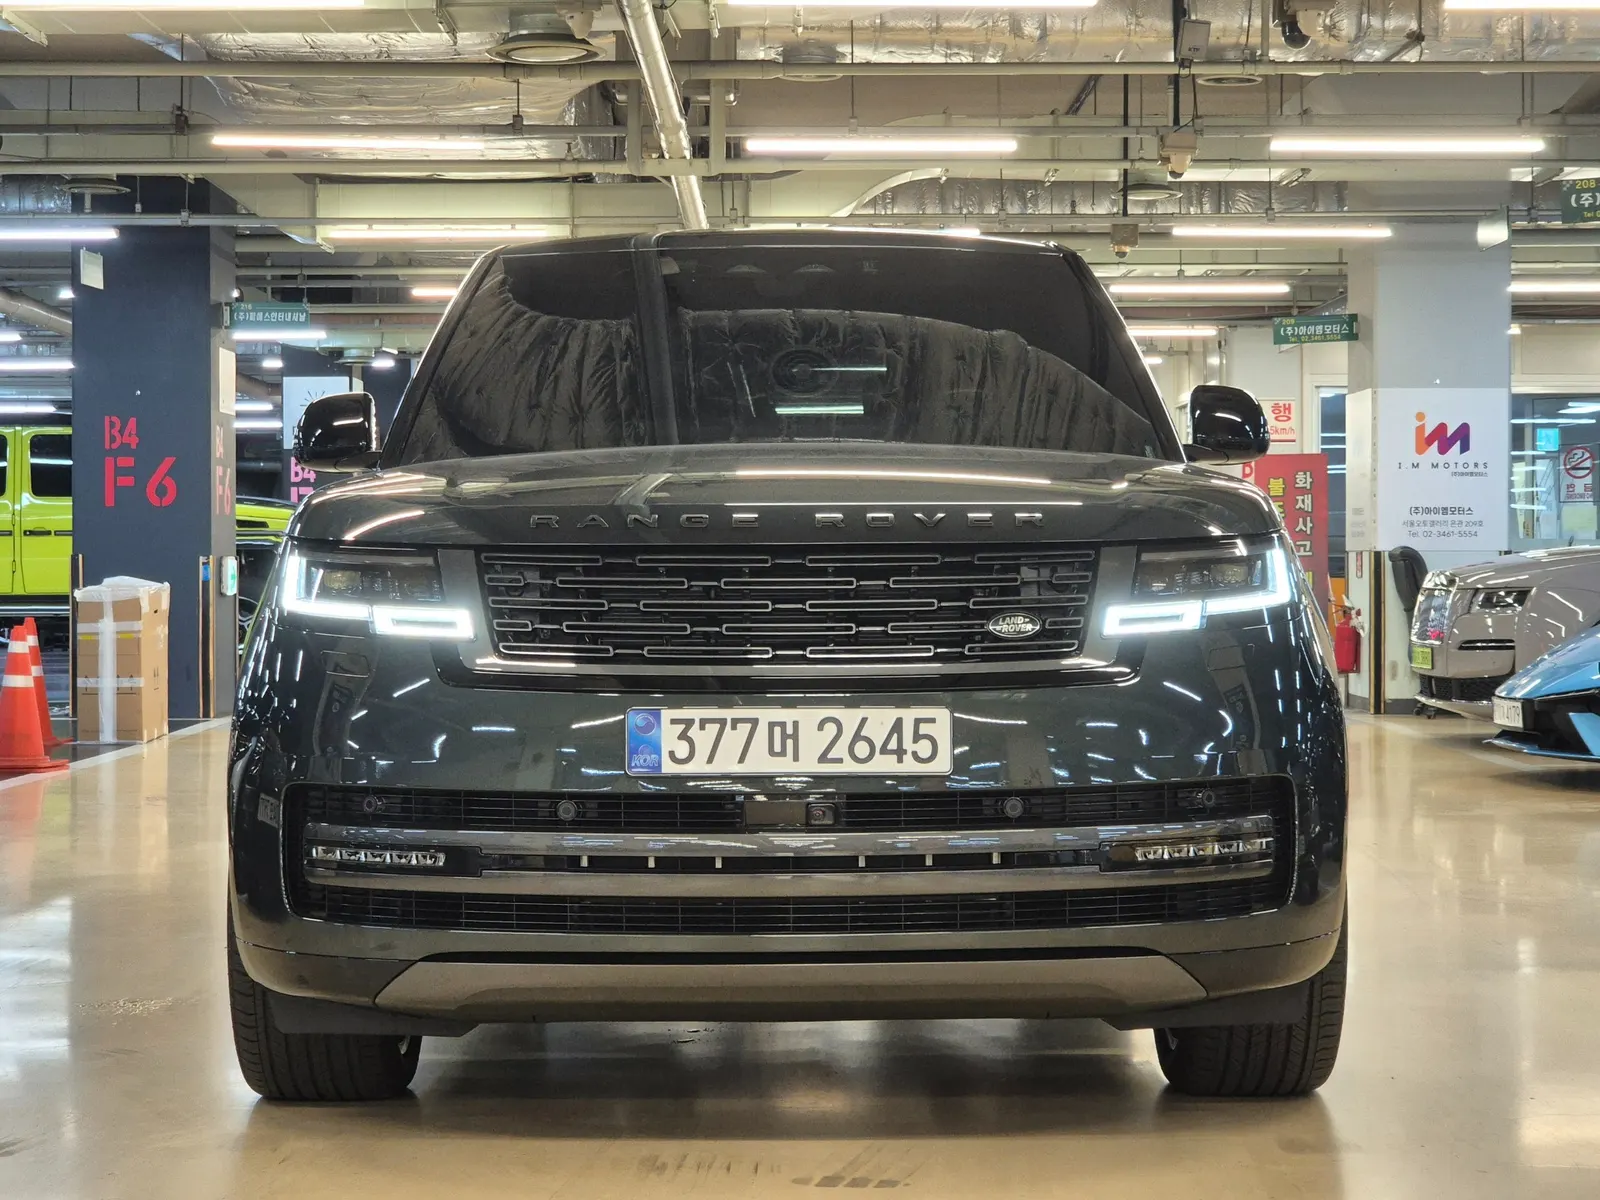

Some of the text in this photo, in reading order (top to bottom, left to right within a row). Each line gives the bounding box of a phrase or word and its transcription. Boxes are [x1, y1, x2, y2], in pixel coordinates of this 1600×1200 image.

[1575, 179, 1596, 189] 208
[240, 303, 253, 311] 216
[1281, 318, 1296, 326] 209
[1271, 402, 1292, 423] 행
[104, 415, 140, 450] B4
[290, 456, 317, 483] B4
[530, 513, 1045, 528] RANGE ROVER
[1422, 530, 1478, 538] 02-3461-5554
[999, 616, 1024, 625] LAND
[1002, 624, 1032, 632] ROVER
[668, 716, 939, 765] 377머 2645
[631, 754, 660, 767] KOR
